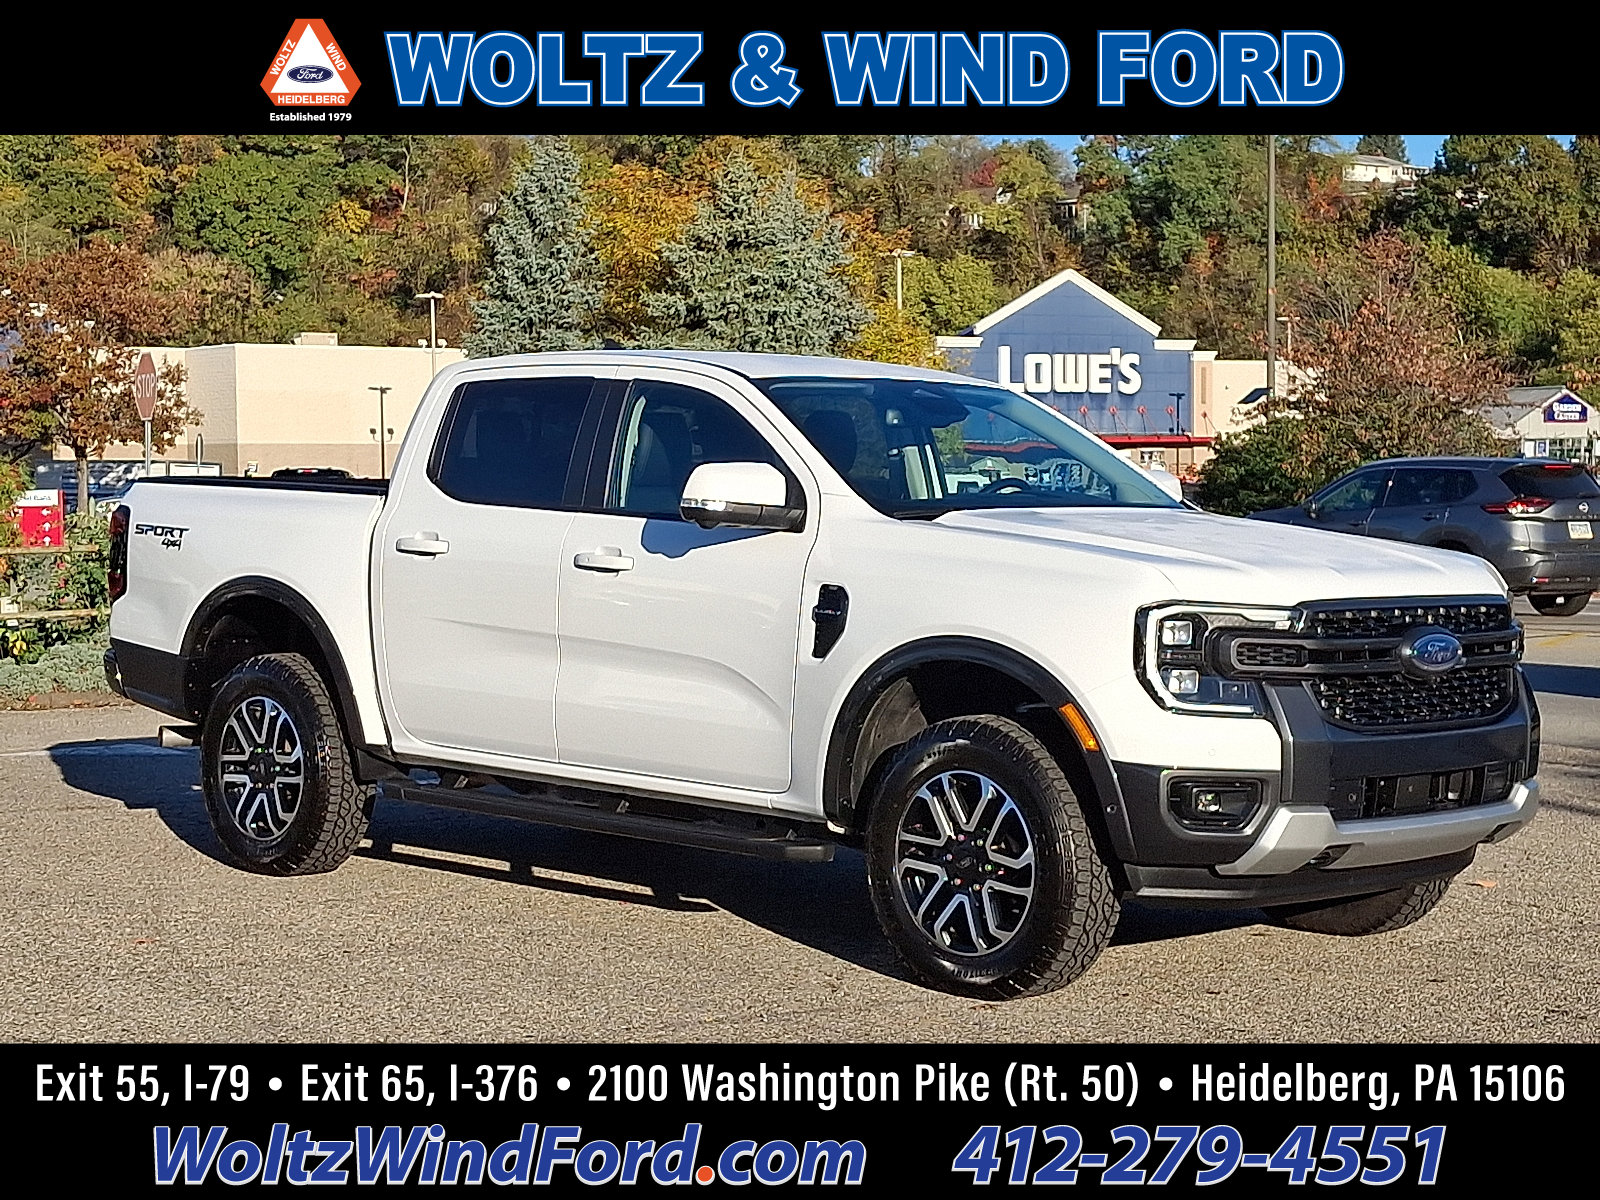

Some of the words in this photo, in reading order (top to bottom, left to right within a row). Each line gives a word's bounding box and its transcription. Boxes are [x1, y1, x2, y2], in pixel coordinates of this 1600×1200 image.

[998, 345, 1142, 395] LOWE'S
[136, 373, 156, 399] STOP
[134, 523, 190, 539] SPORT
